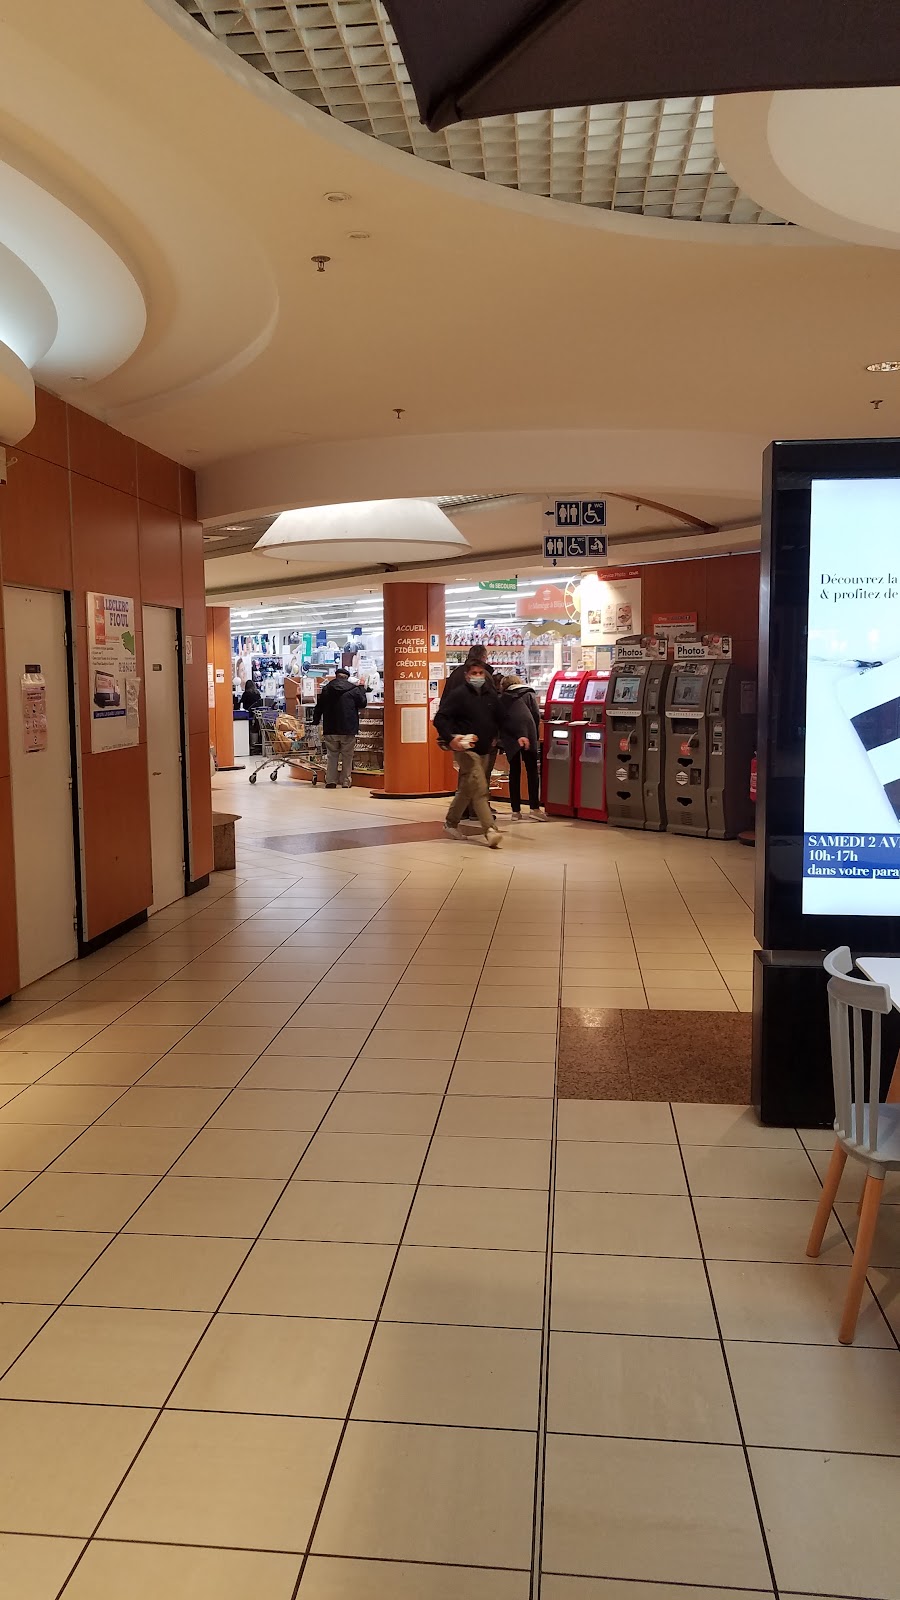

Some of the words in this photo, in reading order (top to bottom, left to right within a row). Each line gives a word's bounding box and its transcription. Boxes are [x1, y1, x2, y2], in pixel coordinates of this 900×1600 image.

[821, 573, 884, 584] Découvrez
[888, 573, 898, 584] la
[820, 589, 829, 599] &
[834, 588, 880, 602] profitez
[884, 588, 898, 599] de
[110, 613, 129, 627] FIOUL
[394, 645, 427, 654] FIDÉLITÉ
[618, 648, 642, 656] Photos
[678, 646, 705, 654] Photos
[396, 658, 427, 667] CRÉDITS
[808, 835, 865, 848] SAMEDI
[868, 836, 876, 848] 2
[878, 836, 900, 848] AV
[809, 850, 858, 861] 10h-17h
[807, 864, 836, 875] dans
[839, 867, 869, 876] votre
